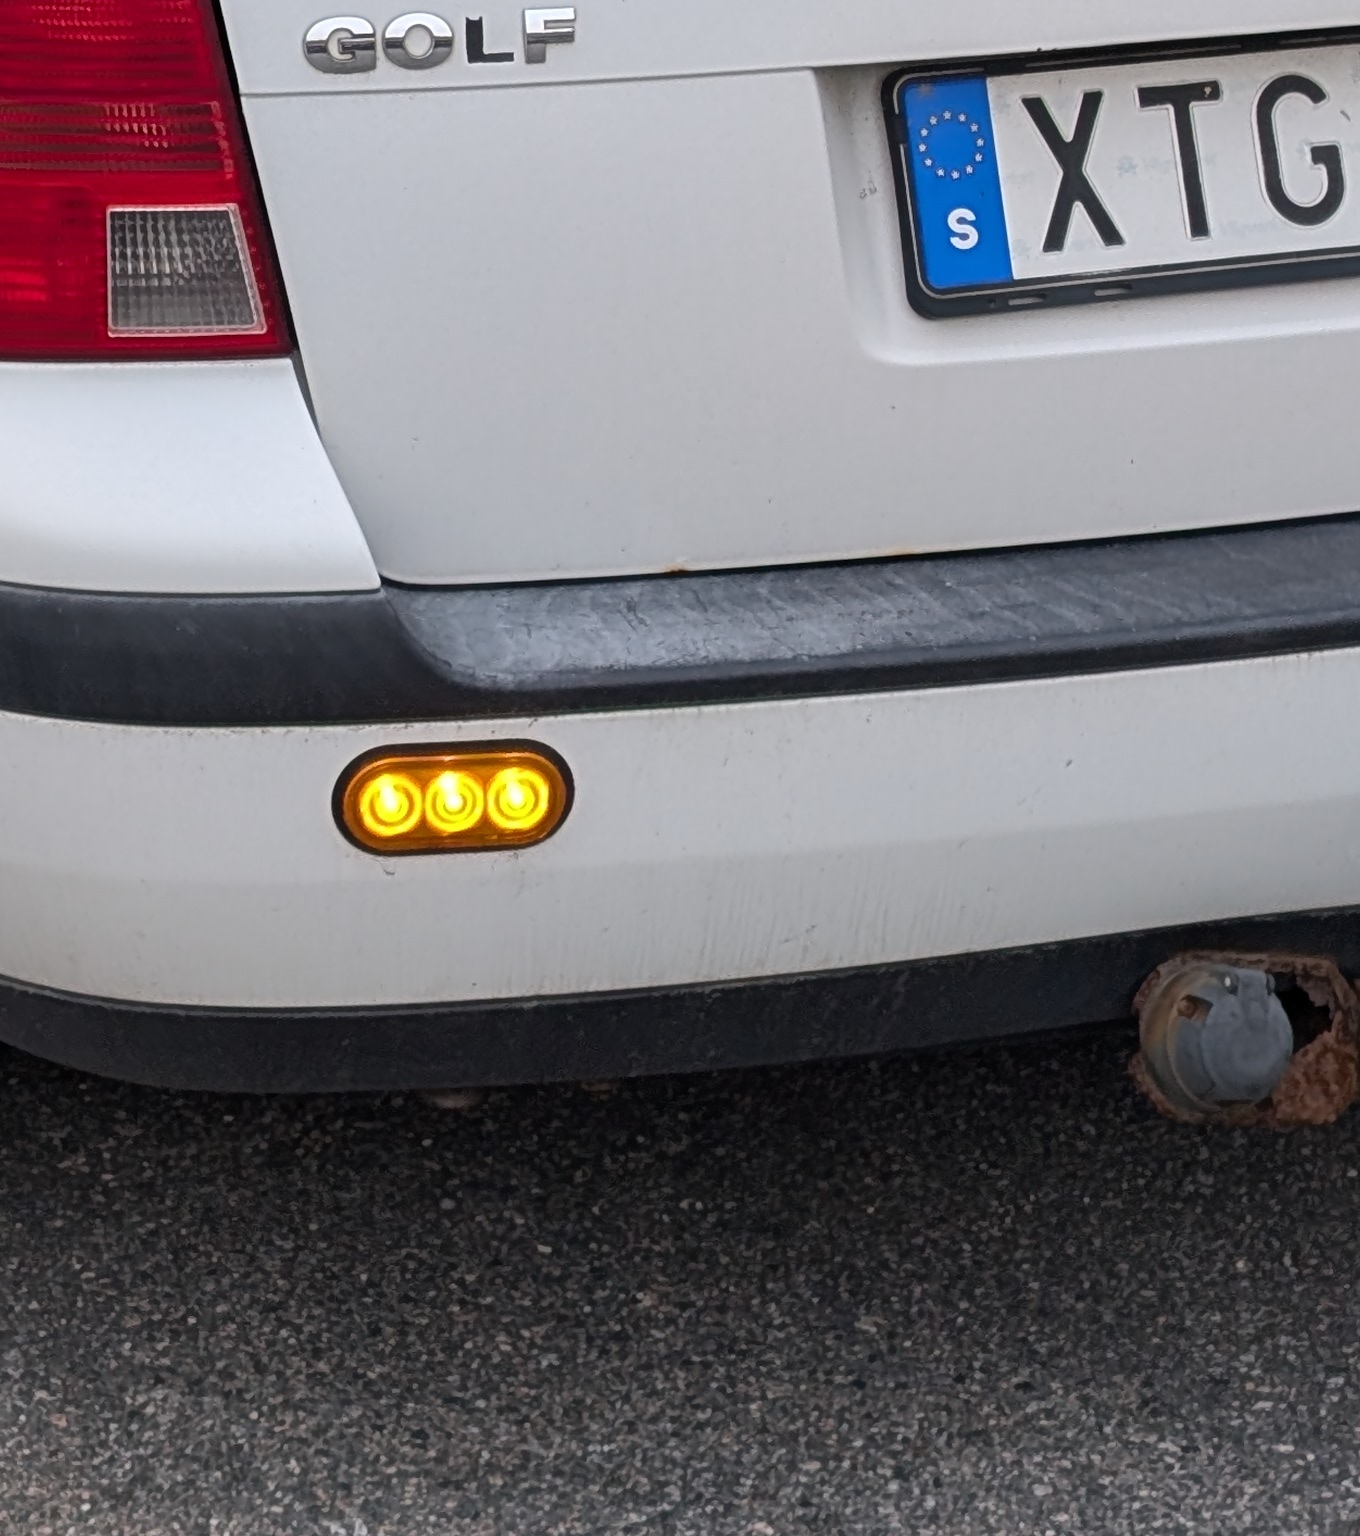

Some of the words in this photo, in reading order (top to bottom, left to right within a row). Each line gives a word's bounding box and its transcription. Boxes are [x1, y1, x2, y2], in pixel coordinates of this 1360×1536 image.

[303, 7, 576, 75] GOLF
[1021, 74, 1345, 254] XTG
[947, 207, 980, 252] S
